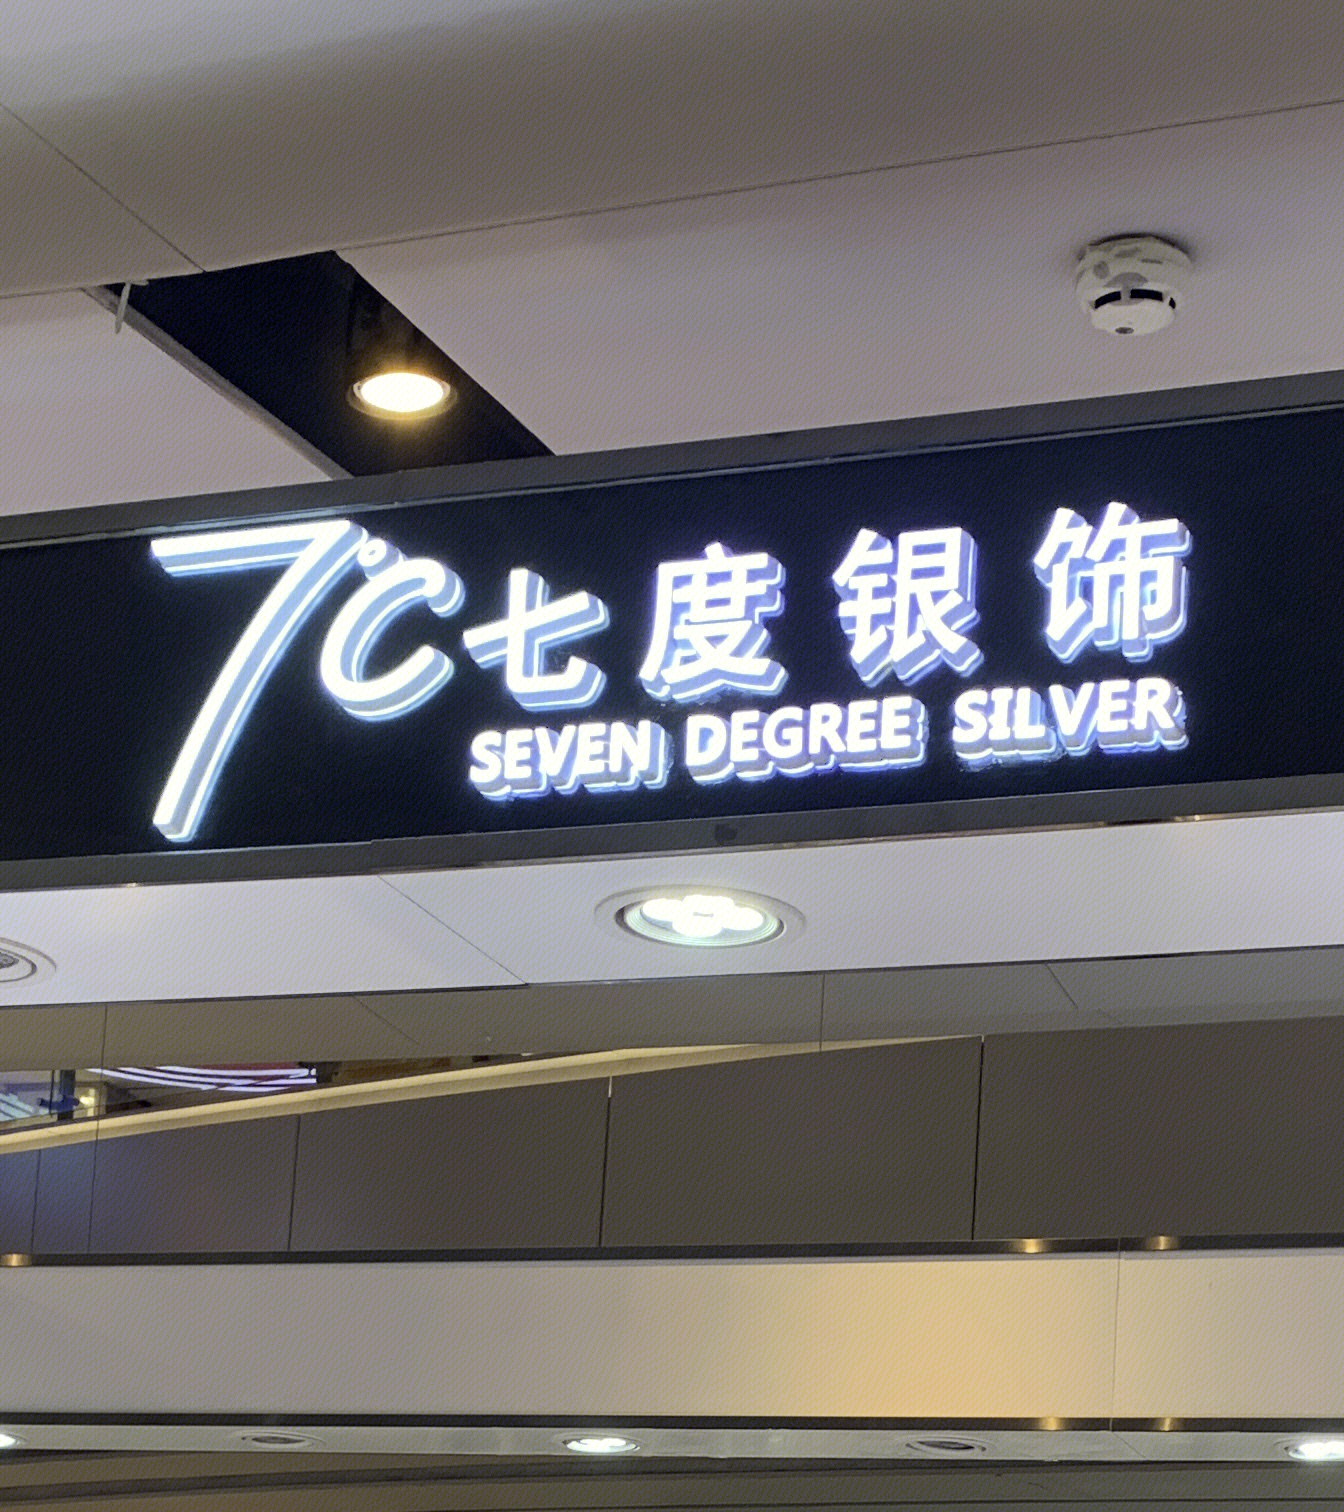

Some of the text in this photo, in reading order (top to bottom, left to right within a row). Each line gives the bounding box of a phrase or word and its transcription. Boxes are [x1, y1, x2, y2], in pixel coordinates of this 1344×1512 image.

[464, 501, 1193, 711] 七度银饰
[468, 676, 1190, 800] SEVEN DEGREE SILVER
